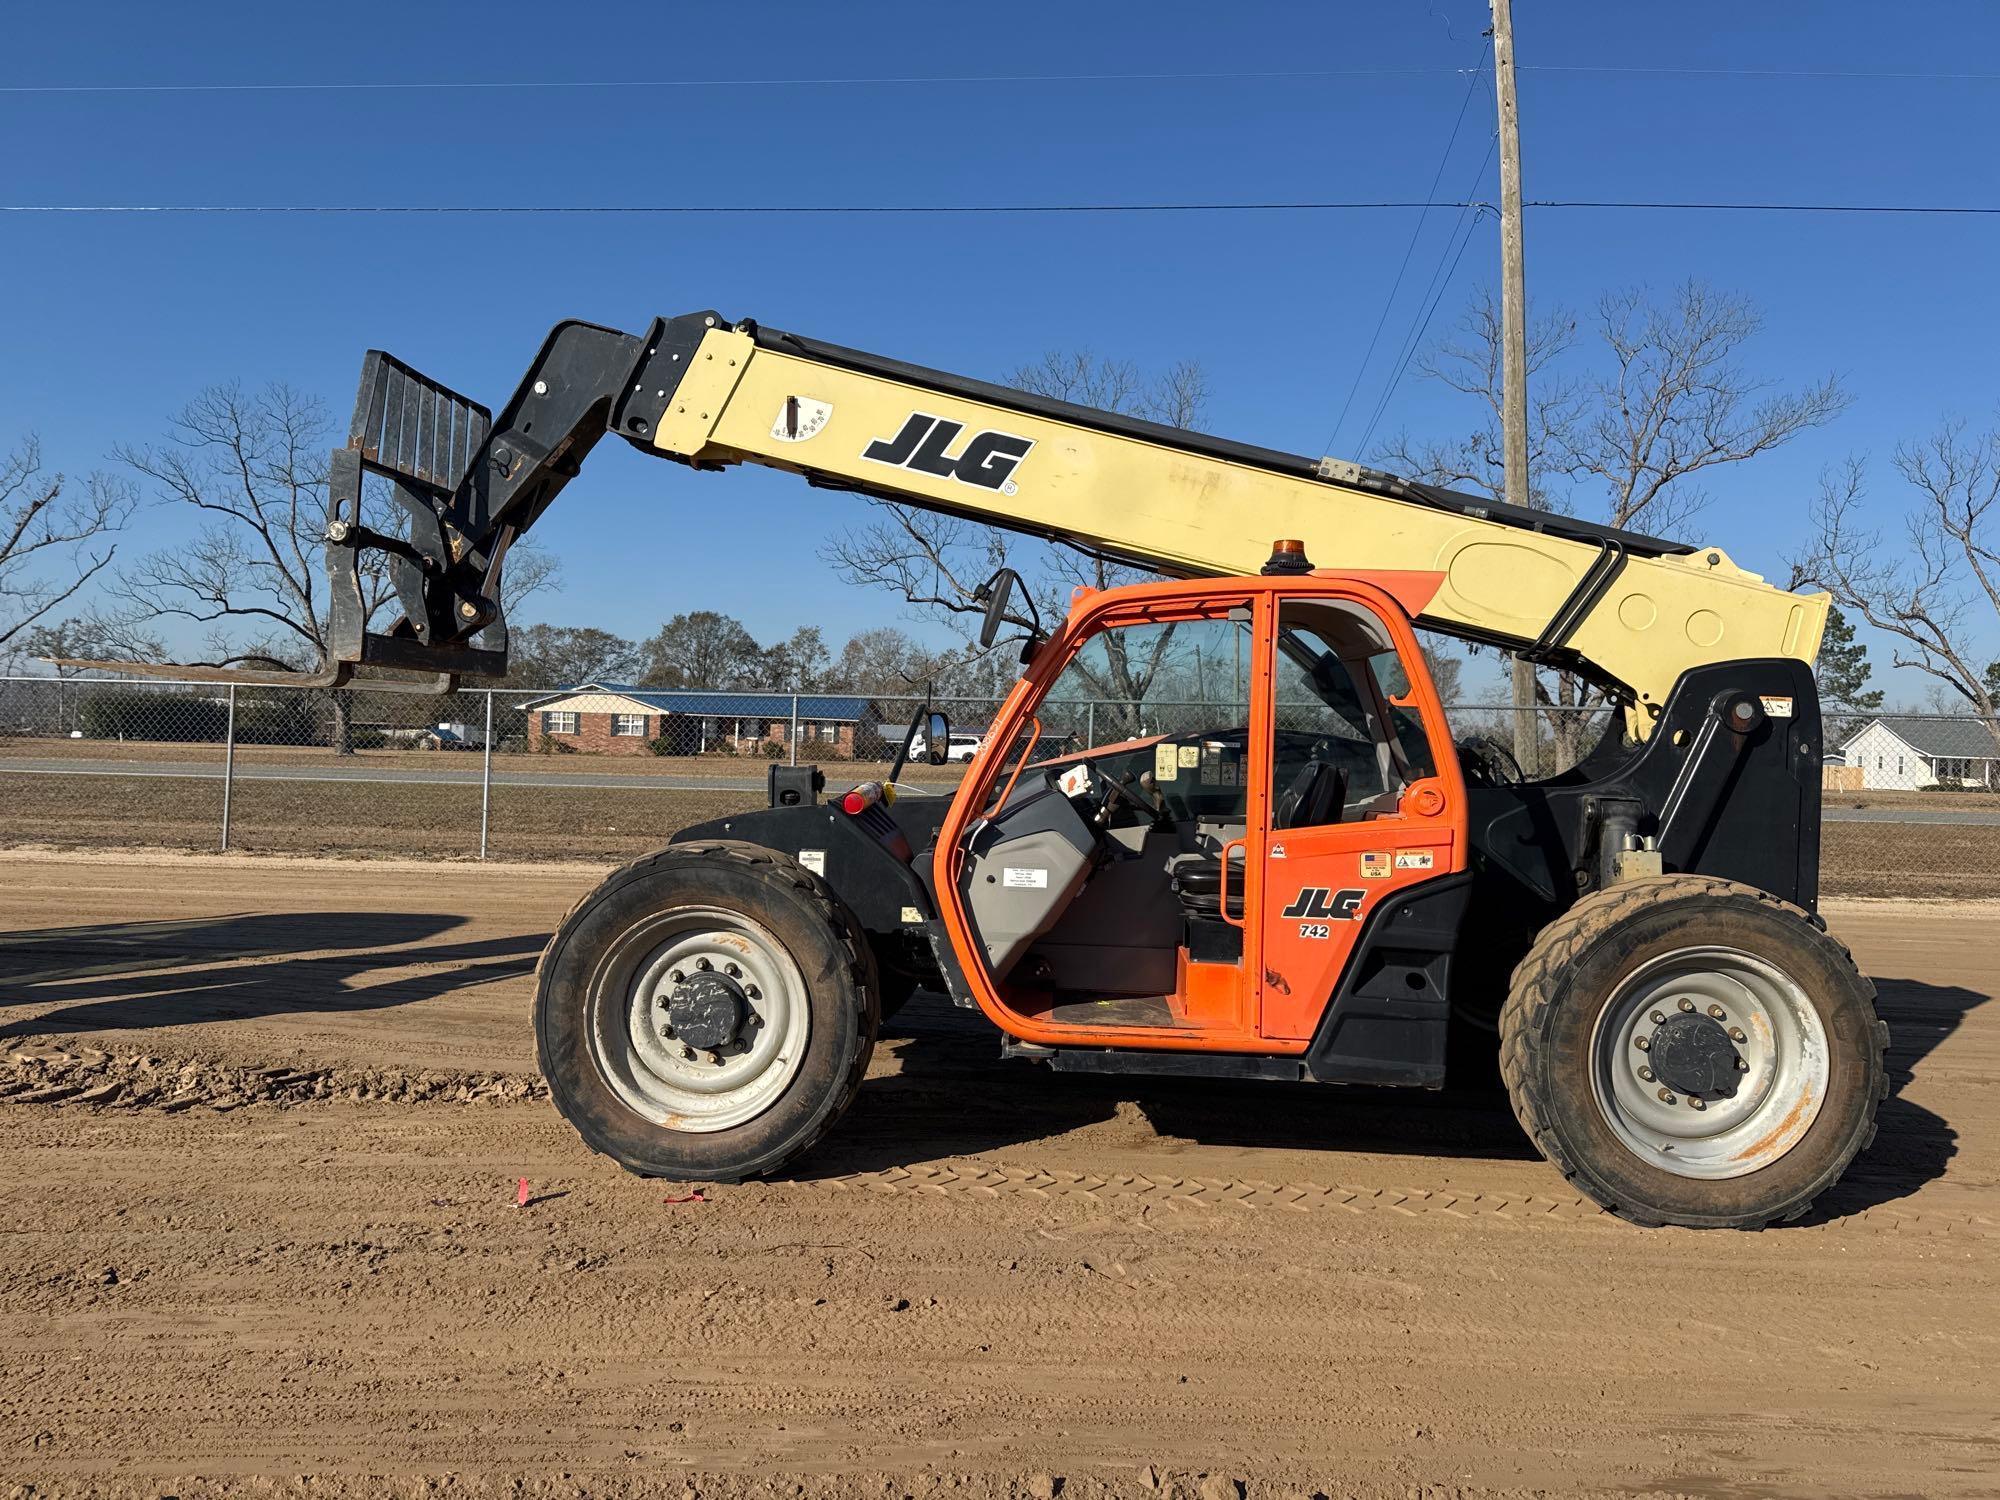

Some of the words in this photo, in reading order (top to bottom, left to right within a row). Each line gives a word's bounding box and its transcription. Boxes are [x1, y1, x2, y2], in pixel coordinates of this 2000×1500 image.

[862, 412, 1034, 490] JLG
[1283, 888, 1366, 919] JLG
[1300, 925, 1329, 938] 742
